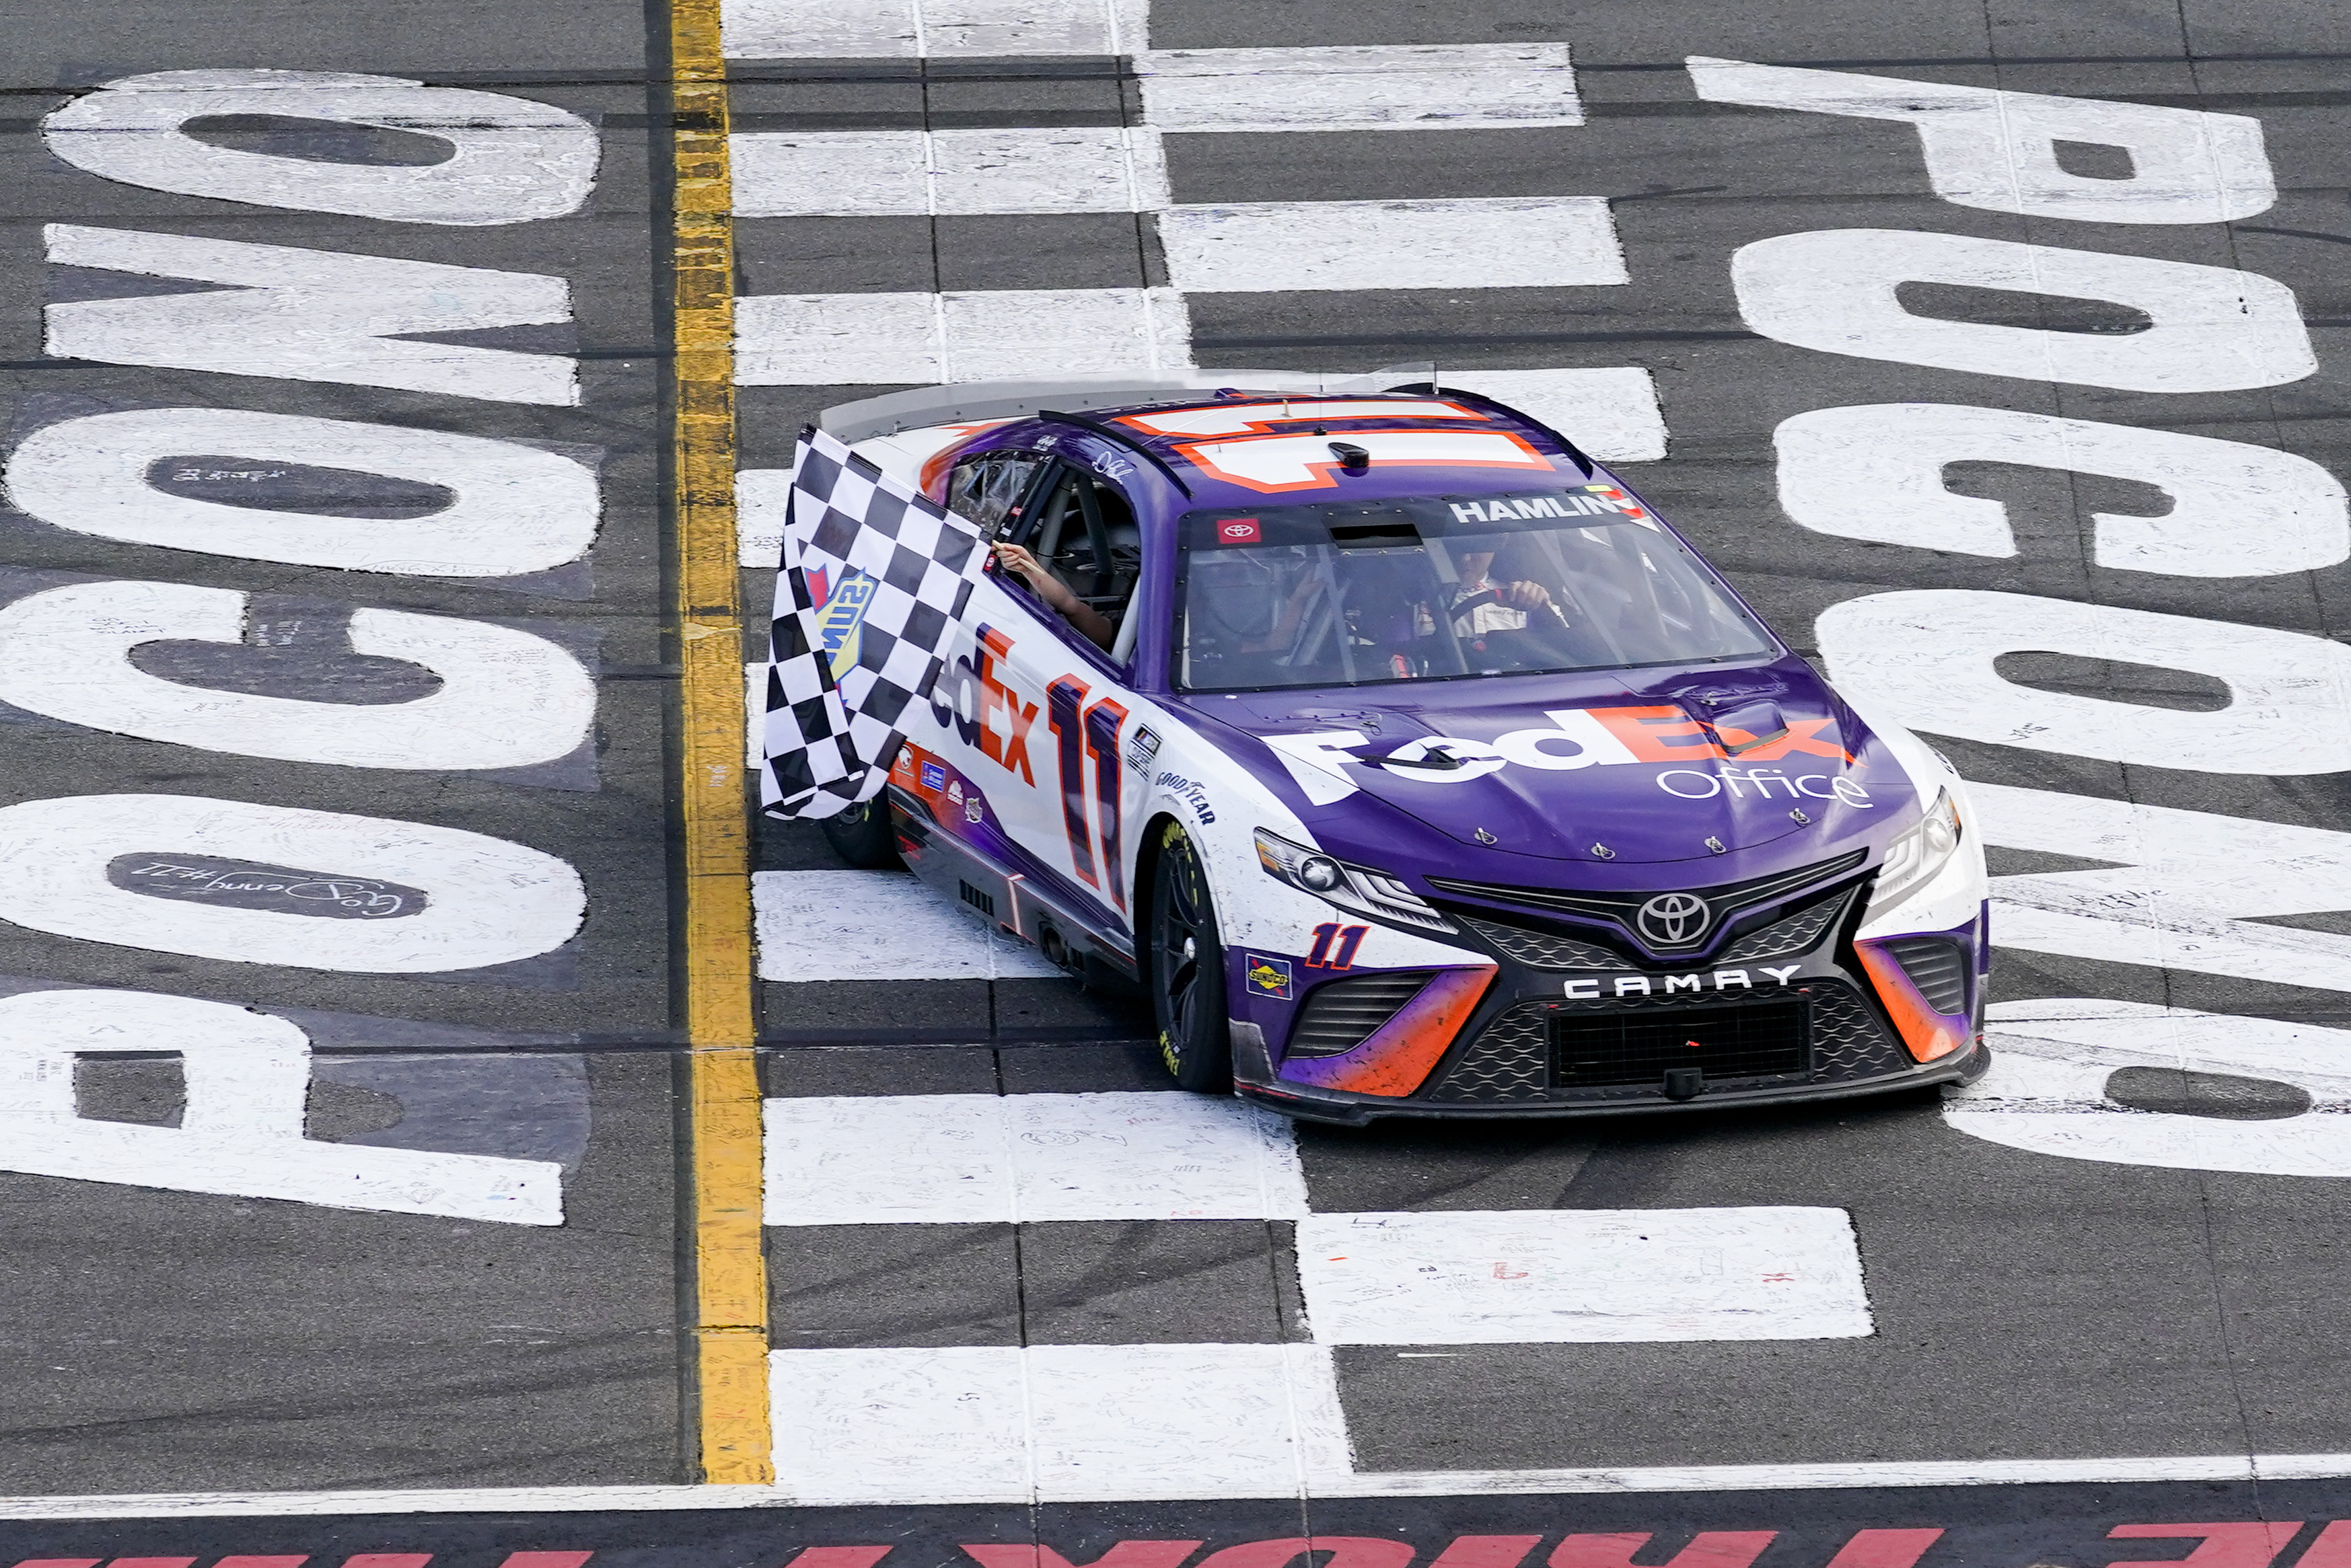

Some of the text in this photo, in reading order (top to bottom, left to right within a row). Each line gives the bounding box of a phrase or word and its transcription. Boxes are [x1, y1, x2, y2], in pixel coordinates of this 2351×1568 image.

[1112, 400, 1556, 494] 11
[1448, 494, 1622, 523] HAMLIN
[0, 68, 601, 1227] POCONO
[1685, 54, 2351, 1178] POCONO
[930, 622, 1040, 789] edEx
[1260, 704, 1868, 806] FedEx
[1656, 766, 1874, 809] Office
[1046, 673, 1130, 916] 11
[1155, 772, 1216, 825] GOODYEAR
[204, 871, 386, 901] Denny
[1304, 922, 1371, 971] 11
[1563, 964, 1803, 1000] CAMRY
